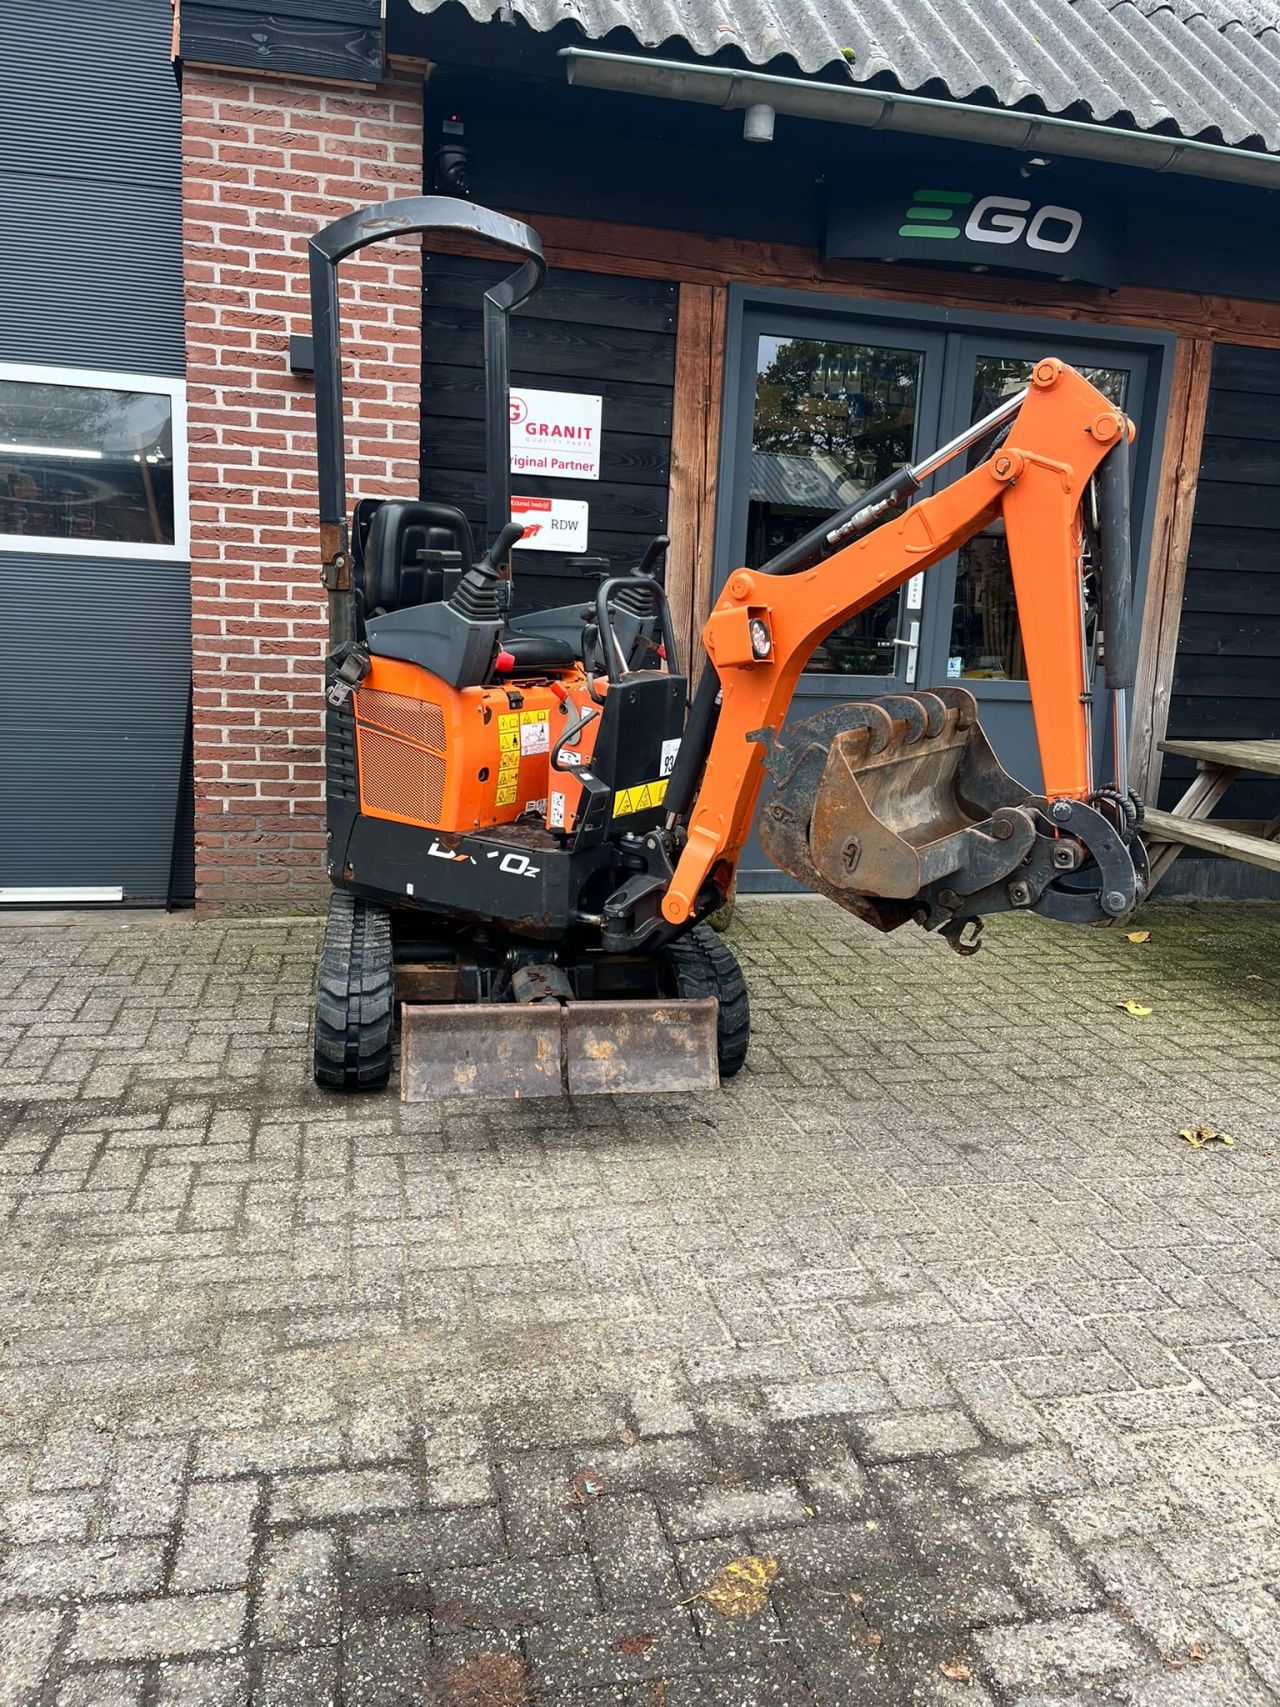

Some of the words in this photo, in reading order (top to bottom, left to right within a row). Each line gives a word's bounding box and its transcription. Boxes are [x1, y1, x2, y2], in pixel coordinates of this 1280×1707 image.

[898, 189, 1083, 254] EGO
[525, 422, 593, 440] GRANIT
[510, 454, 547, 469] riginal
[551, 458, 595, 472] Partner
[550, 518, 579, 531] RDW
